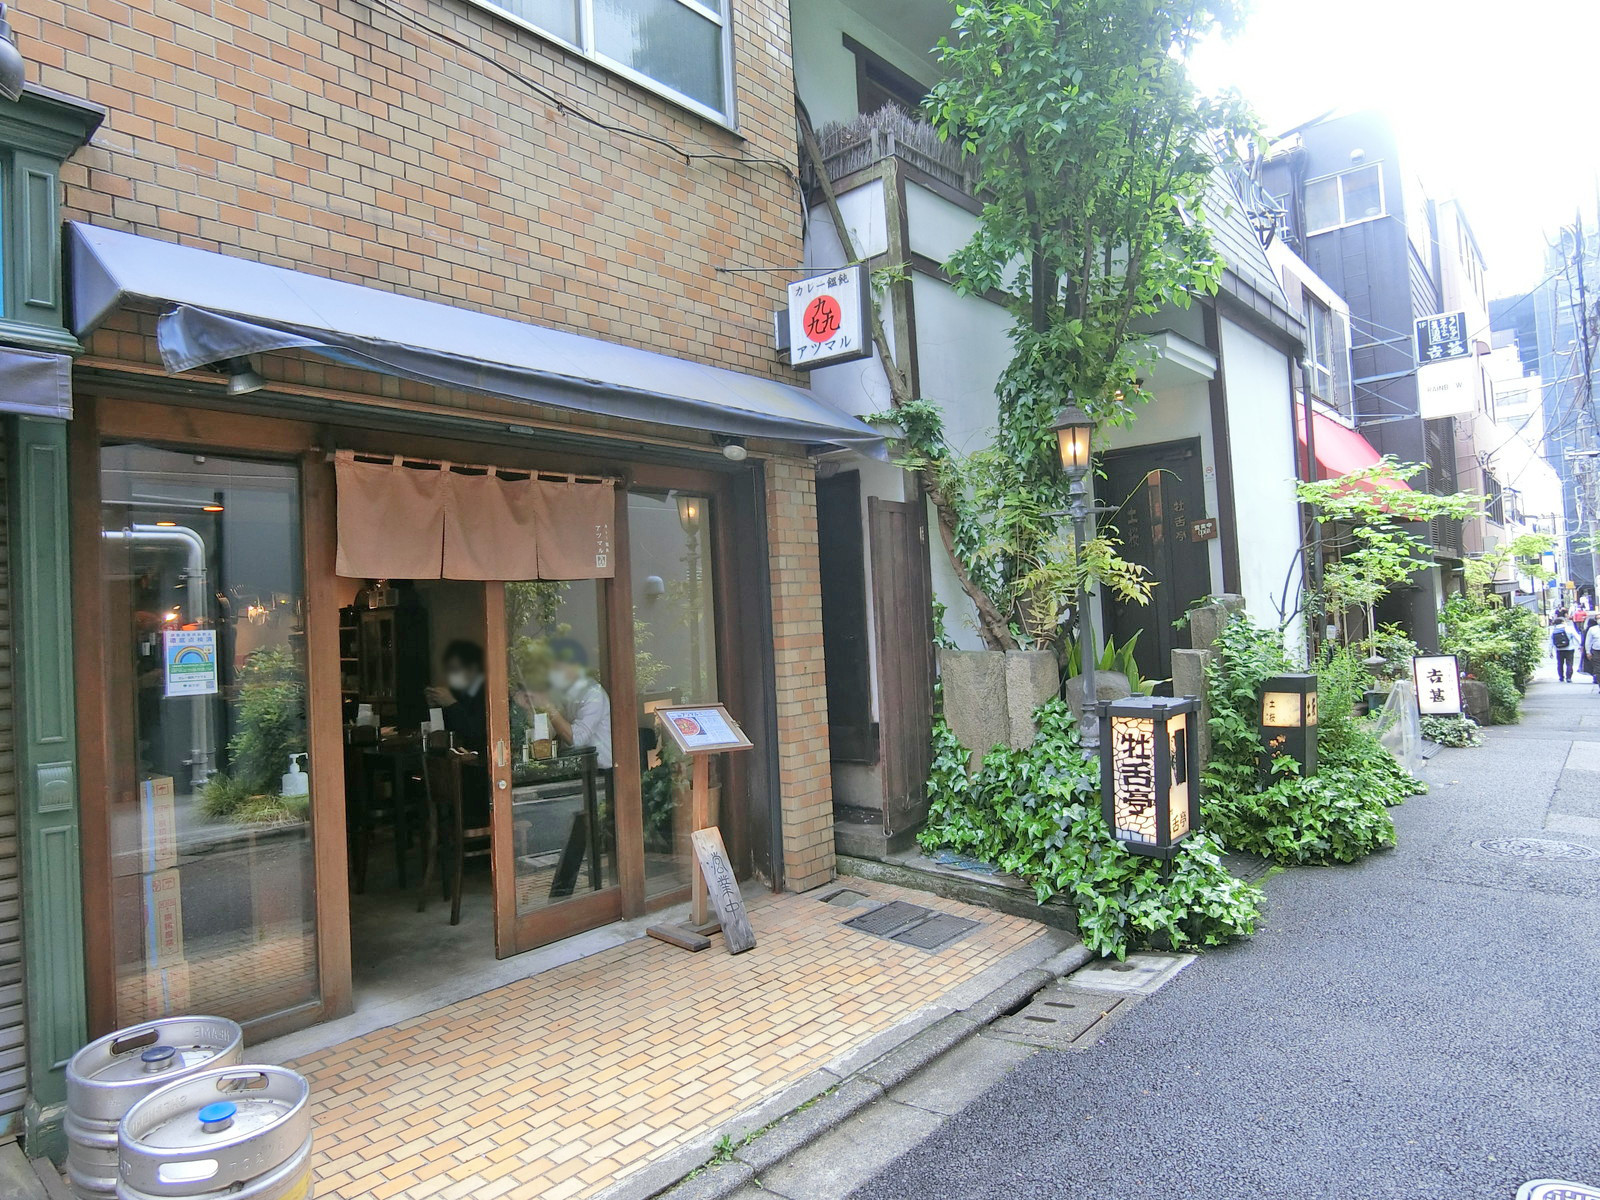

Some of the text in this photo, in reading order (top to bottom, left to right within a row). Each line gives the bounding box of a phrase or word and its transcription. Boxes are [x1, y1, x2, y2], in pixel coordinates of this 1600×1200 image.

[1417, 321, 1427, 329] 1F
[797, 336, 851, 359] アツマル
[1427, 382, 1462, 392] RAINBW
[711, 851, 740, 919] 営業中
